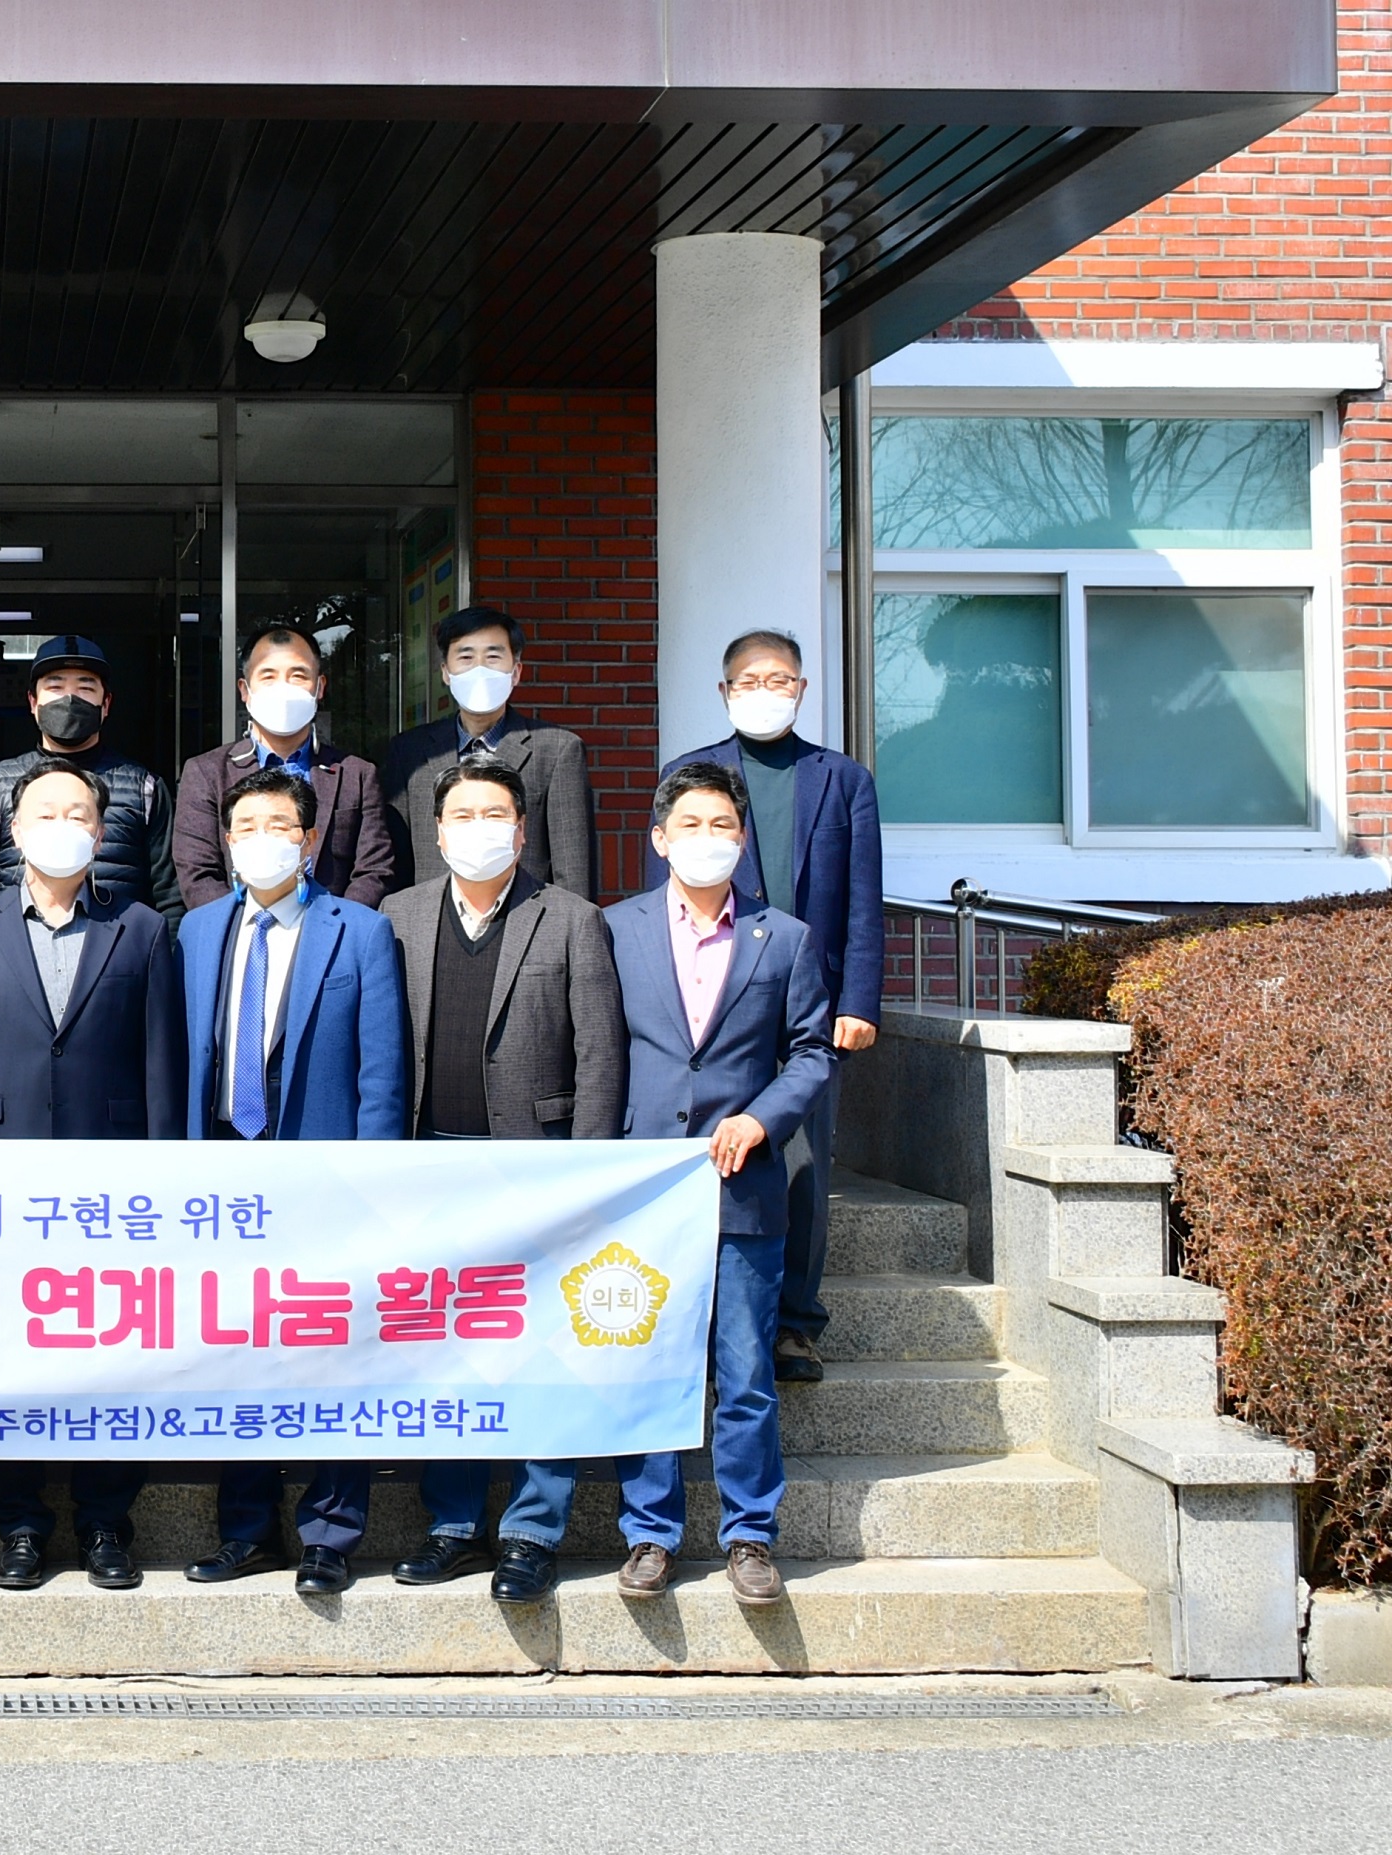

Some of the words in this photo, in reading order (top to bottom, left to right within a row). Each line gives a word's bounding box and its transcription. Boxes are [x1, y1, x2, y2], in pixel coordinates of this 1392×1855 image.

[23, 1193, 163, 1241] 구현을
[179, 1193, 273, 1241] 위한
[21, 1266, 175, 1350] 연계
[201, 1267, 353, 1348] 나눔
[376, 1263, 528, 1343] 활동
[591, 1286, 638, 1312] 의회
